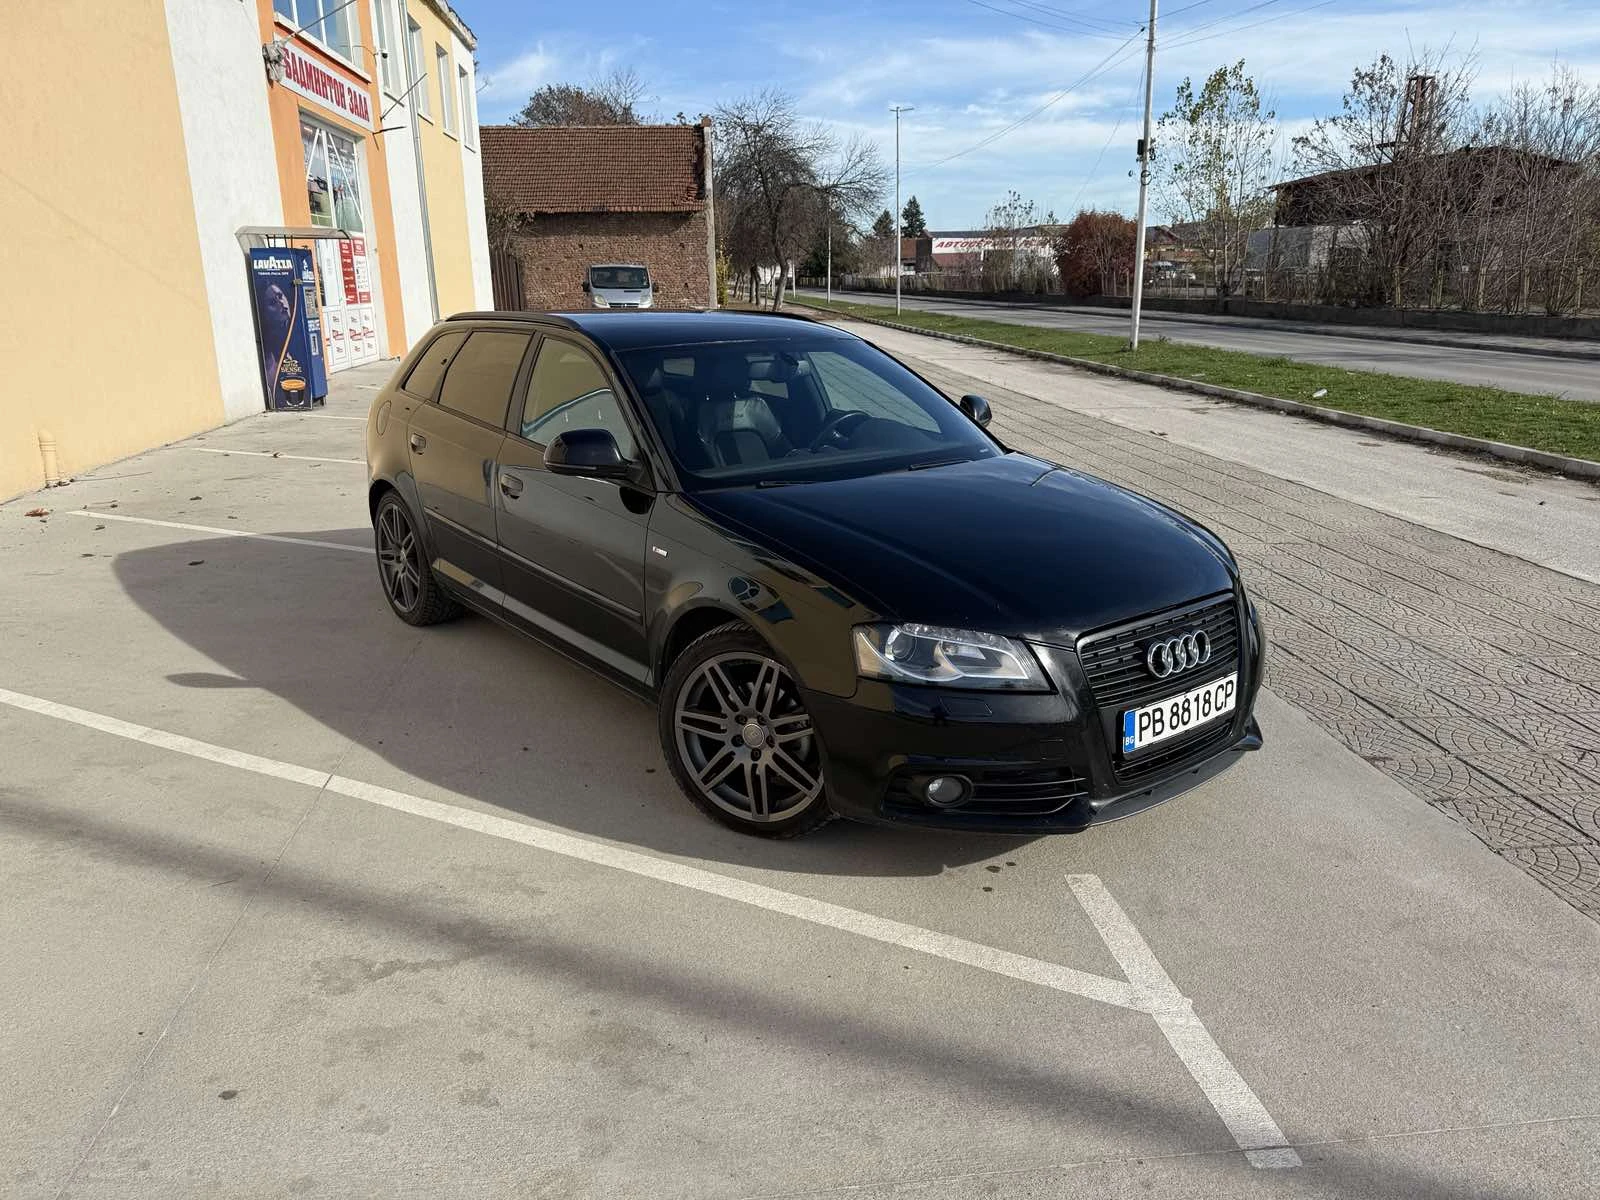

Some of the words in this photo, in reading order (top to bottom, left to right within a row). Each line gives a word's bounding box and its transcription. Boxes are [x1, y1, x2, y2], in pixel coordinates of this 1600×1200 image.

[283, 47, 346, 110] БАДМИНТОН
[347, 87, 370, 122] ЗАЛА
[253, 256, 293, 269] LAVAZZA
[1138, 707, 1165, 742] PB
[1169, 690, 1212, 730] 8818
[1214, 680, 1235, 712] CP
[1125, 736, 1135, 745] BG
